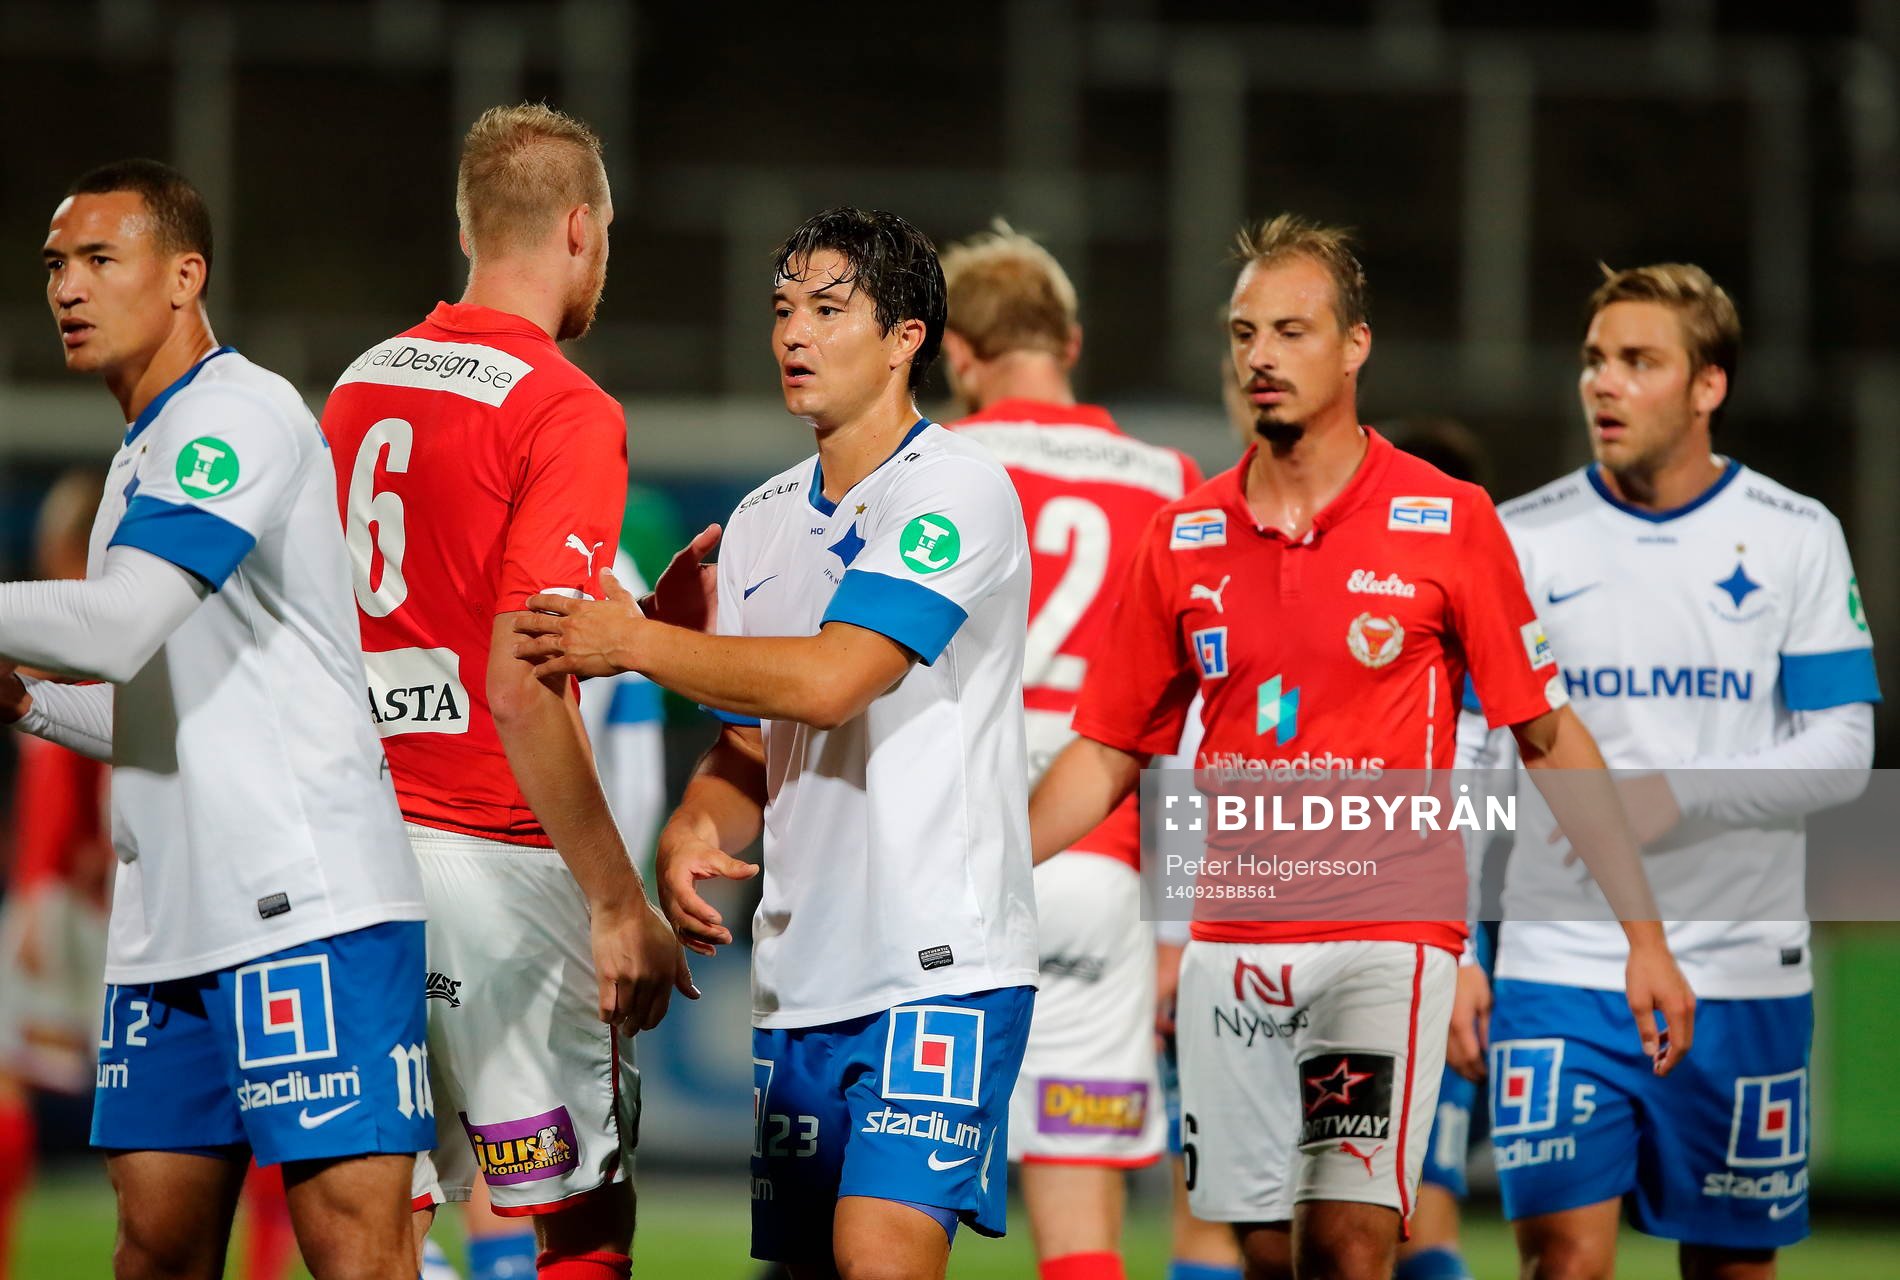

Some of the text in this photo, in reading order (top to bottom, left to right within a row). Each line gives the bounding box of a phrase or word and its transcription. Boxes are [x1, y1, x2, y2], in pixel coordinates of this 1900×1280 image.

[346, 418, 413, 617] 6
[1022, 496, 1111, 692] 2
[1347, 569, 1416, 598] Electra
[1563, 667, 1753, 700] HOLMEN
[126, 1000, 150, 1047] 2
[237, 1067, 361, 1112] stadium
[1572, 1084, 1596, 1124] 5
[768, 1114, 819, 1157] 23
[861, 1106, 981, 1151] stadium
[488, 1151, 572, 1175] kompaniet
